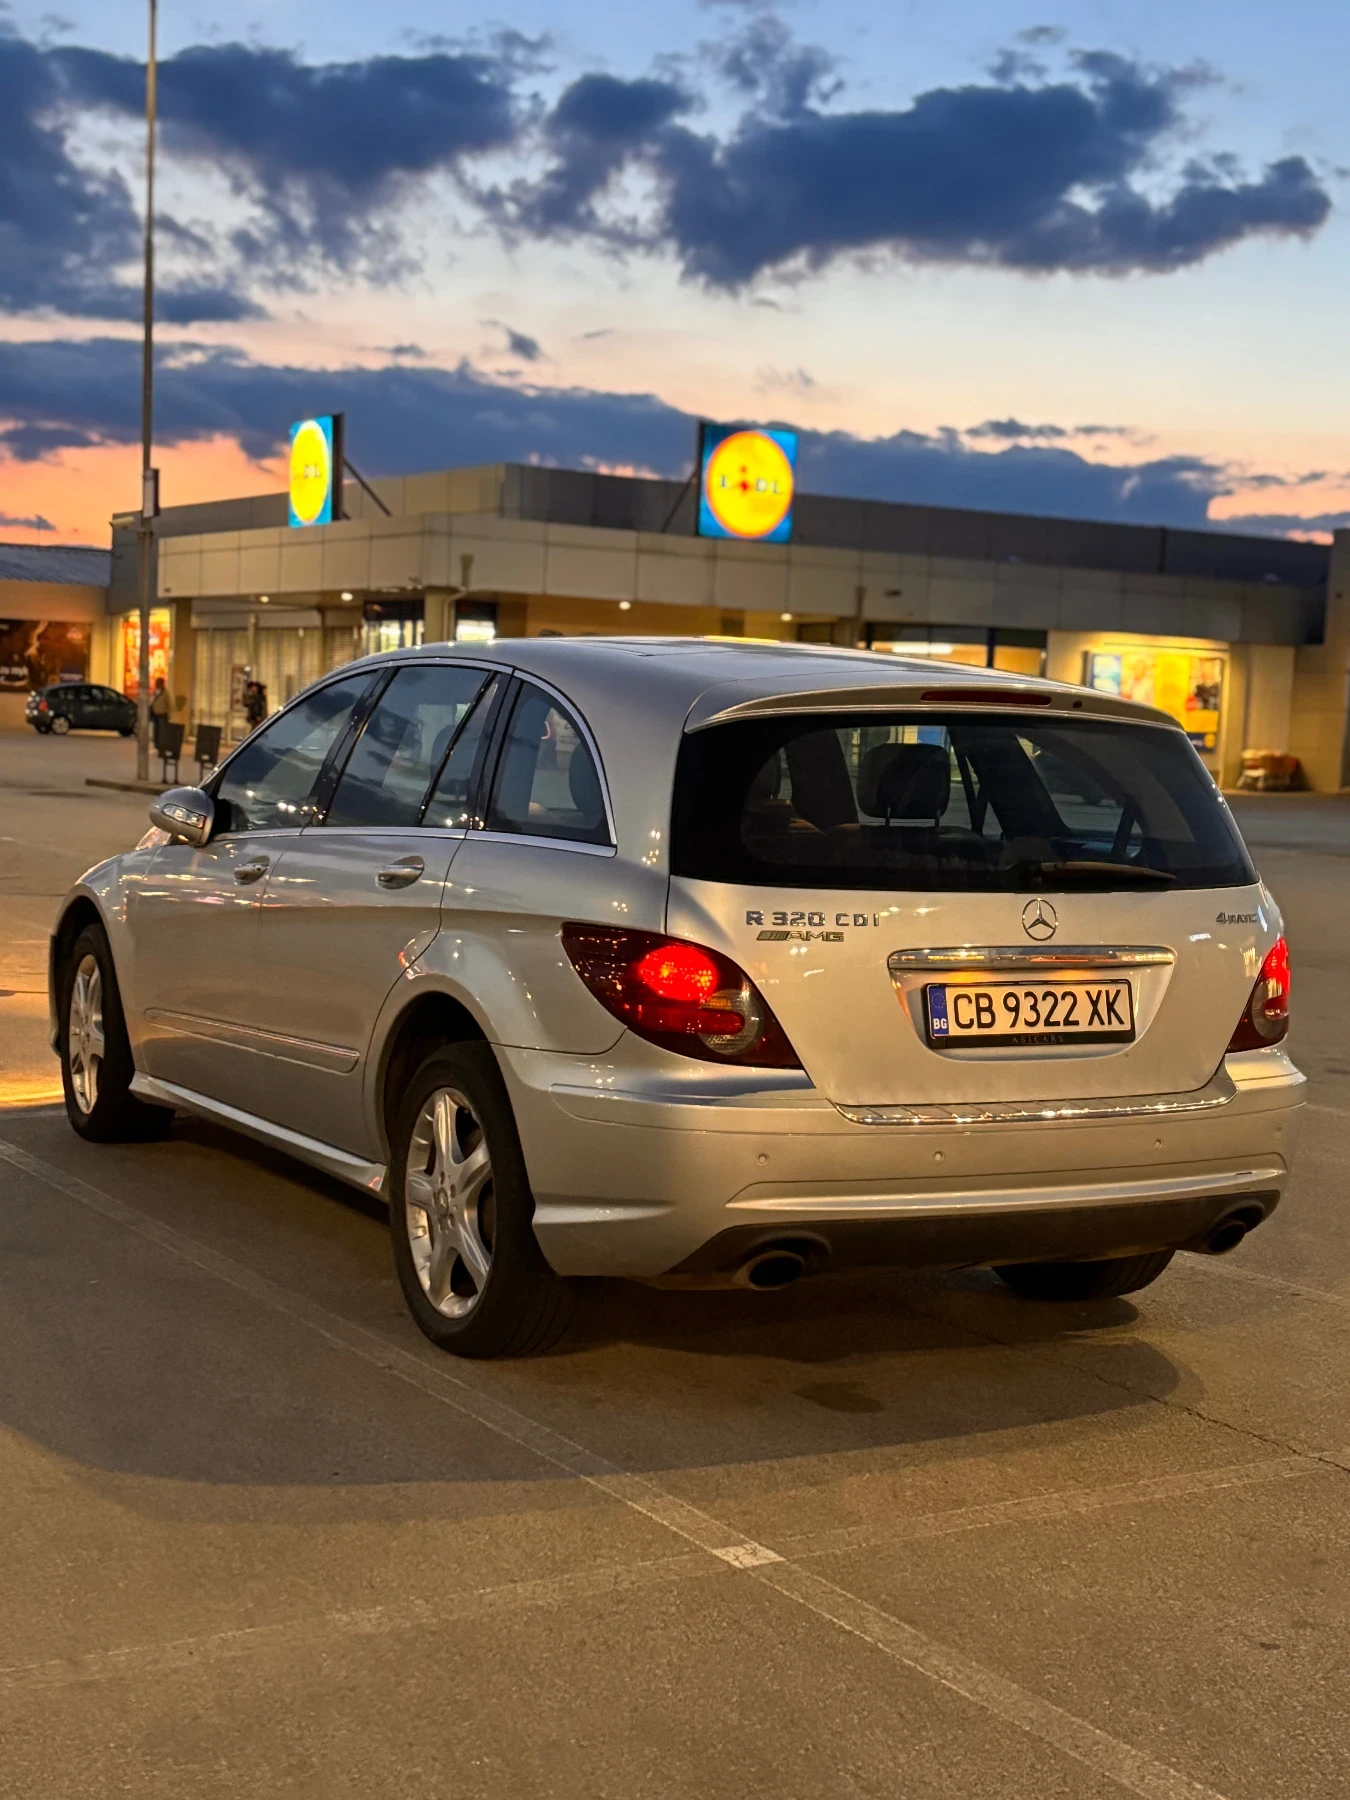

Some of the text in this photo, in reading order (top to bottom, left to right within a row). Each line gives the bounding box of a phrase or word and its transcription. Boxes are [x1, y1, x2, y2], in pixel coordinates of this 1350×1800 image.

[746, 911, 880, 927] R 320 CDI
[787, 930, 844, 942] AMG
[953, 989, 1125, 1029] CB 9322 XK
[933, 1018, 947, 1030] BG
